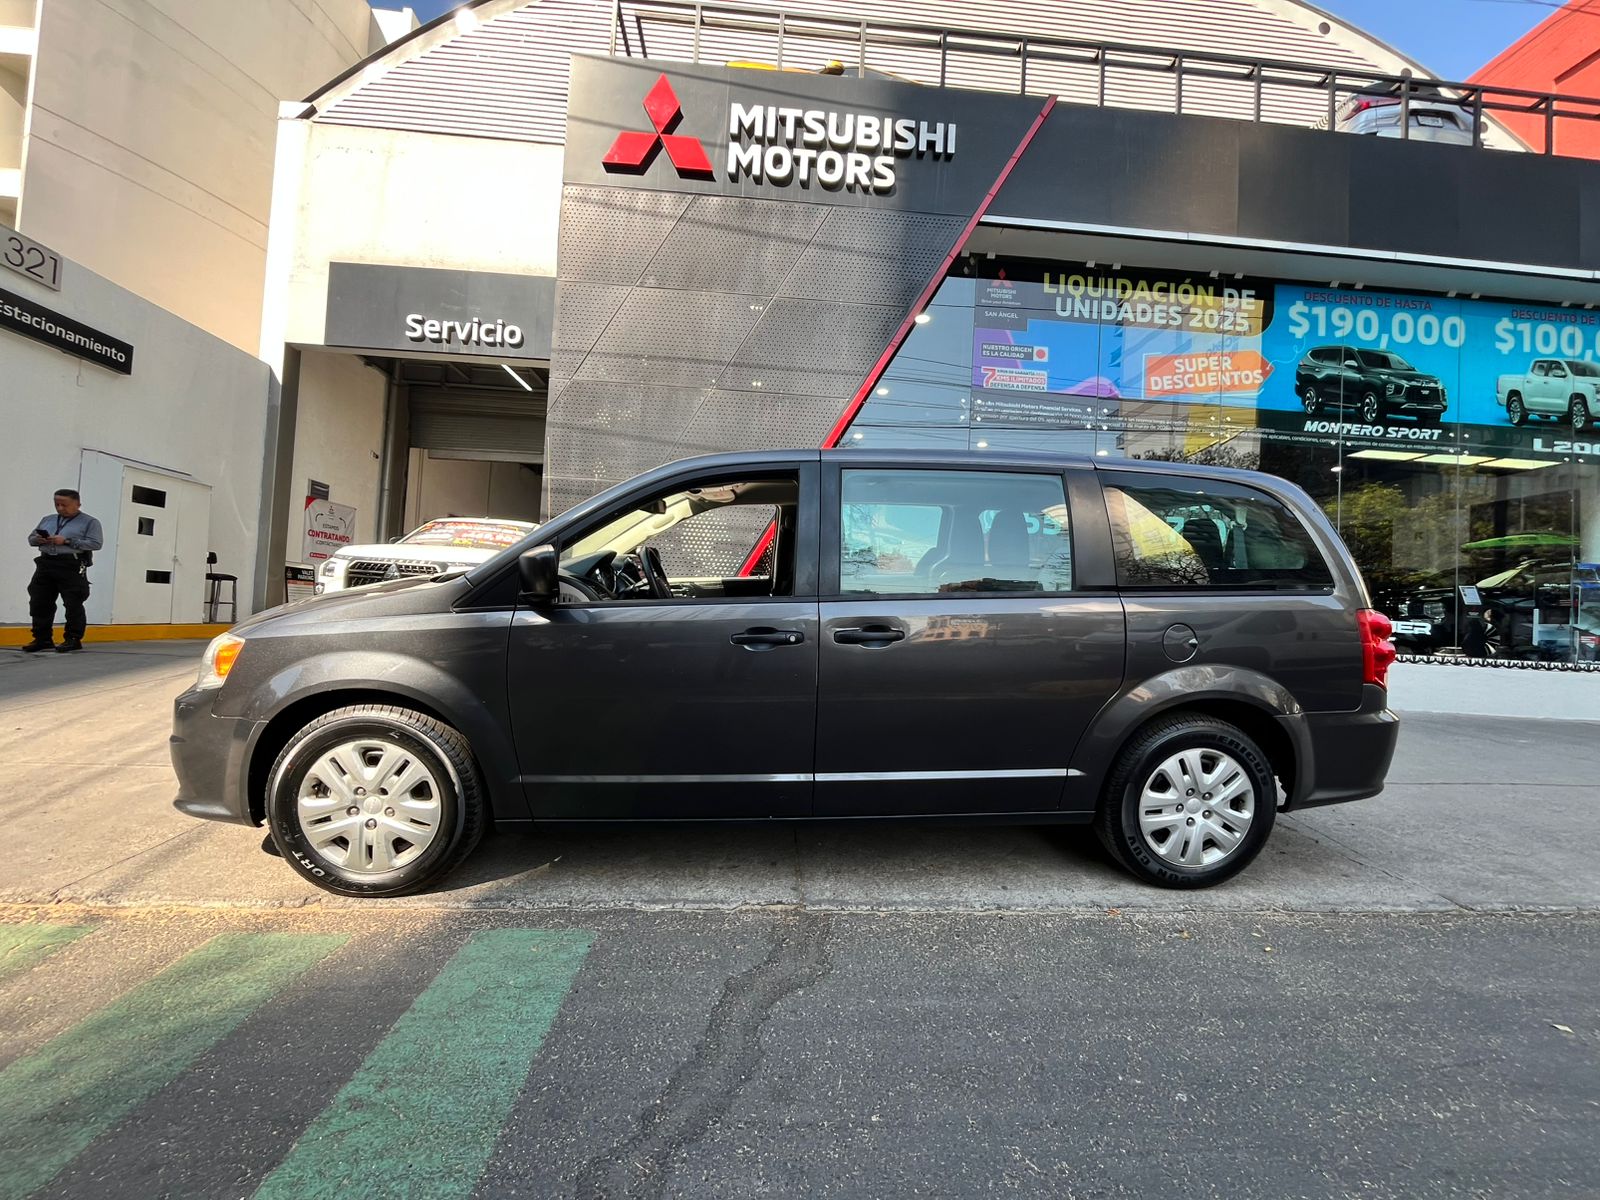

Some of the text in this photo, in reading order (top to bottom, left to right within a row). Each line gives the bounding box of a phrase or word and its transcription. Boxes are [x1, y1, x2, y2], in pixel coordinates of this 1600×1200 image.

[730, 102, 957, 156] MITSUBISHI
[727, 141, 896, 190] MOTORS
[4, 236, 58, 285] 321
[1043, 272, 1256, 311] LIQUIDACIÓN DE
[1303, 290, 1433, 311] DESCUENTO DE HASTA
[1055, 296, 1249, 332] UNIDADES 2025
[1288, 300, 1466, 350] $190,000
[1511, 309, 1596, 325] DESCUENTO DE
[0, 301, 126, 363] stacionamiento
[405, 313, 523, 345] Servicio
[1494, 317, 1600, 361] $100,
[999, 351, 1025, 359] CALIDAD
[1010, 345, 1033, 353] ORIGEN
[1174, 356, 1233, 374] SUPER
[982, 367, 996, 388] 7
[1010, 376, 1046, 385] ILIMITADOS
[1020, 383, 1046, 391] DEFENSA
[1151, 364, 1265, 391] DESCUENTOS
[1304, 420, 1443, 441] MONTERO SPORT
[307, 529, 350, 543] CONTRATANDO
